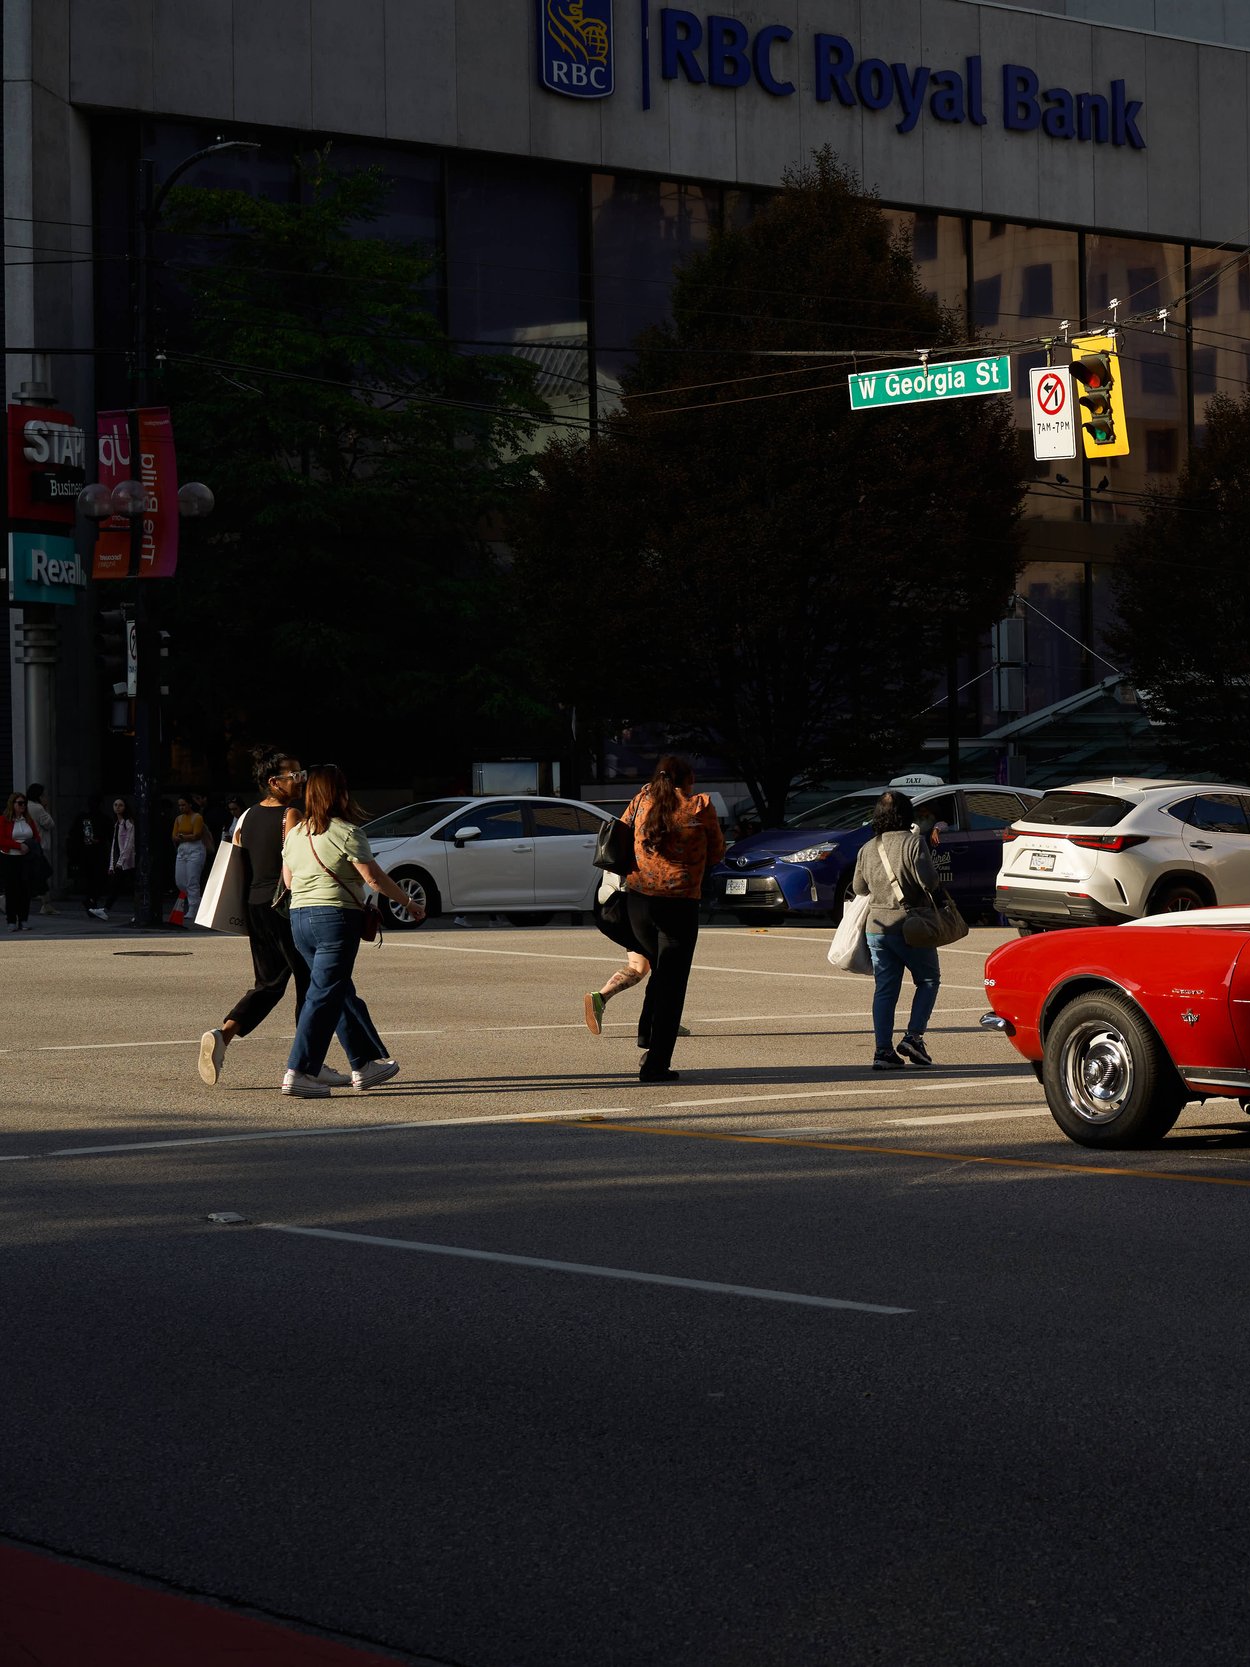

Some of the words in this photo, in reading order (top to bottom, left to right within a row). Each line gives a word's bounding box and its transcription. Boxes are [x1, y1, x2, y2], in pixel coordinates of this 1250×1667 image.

[552, 59, 606, 89] RBC
[661, 8, 795, 97] RBC
[815, 33, 987, 133] Royal
[1003, 64, 1146, 149] Bank
[857, 376, 875, 400] W
[885, 366, 966, 396] Georgia
[975, 361, 999, 386] St
[1037, 421, 1071, 435] 7AM-7PM
[984, 978, 996, 987] SS
